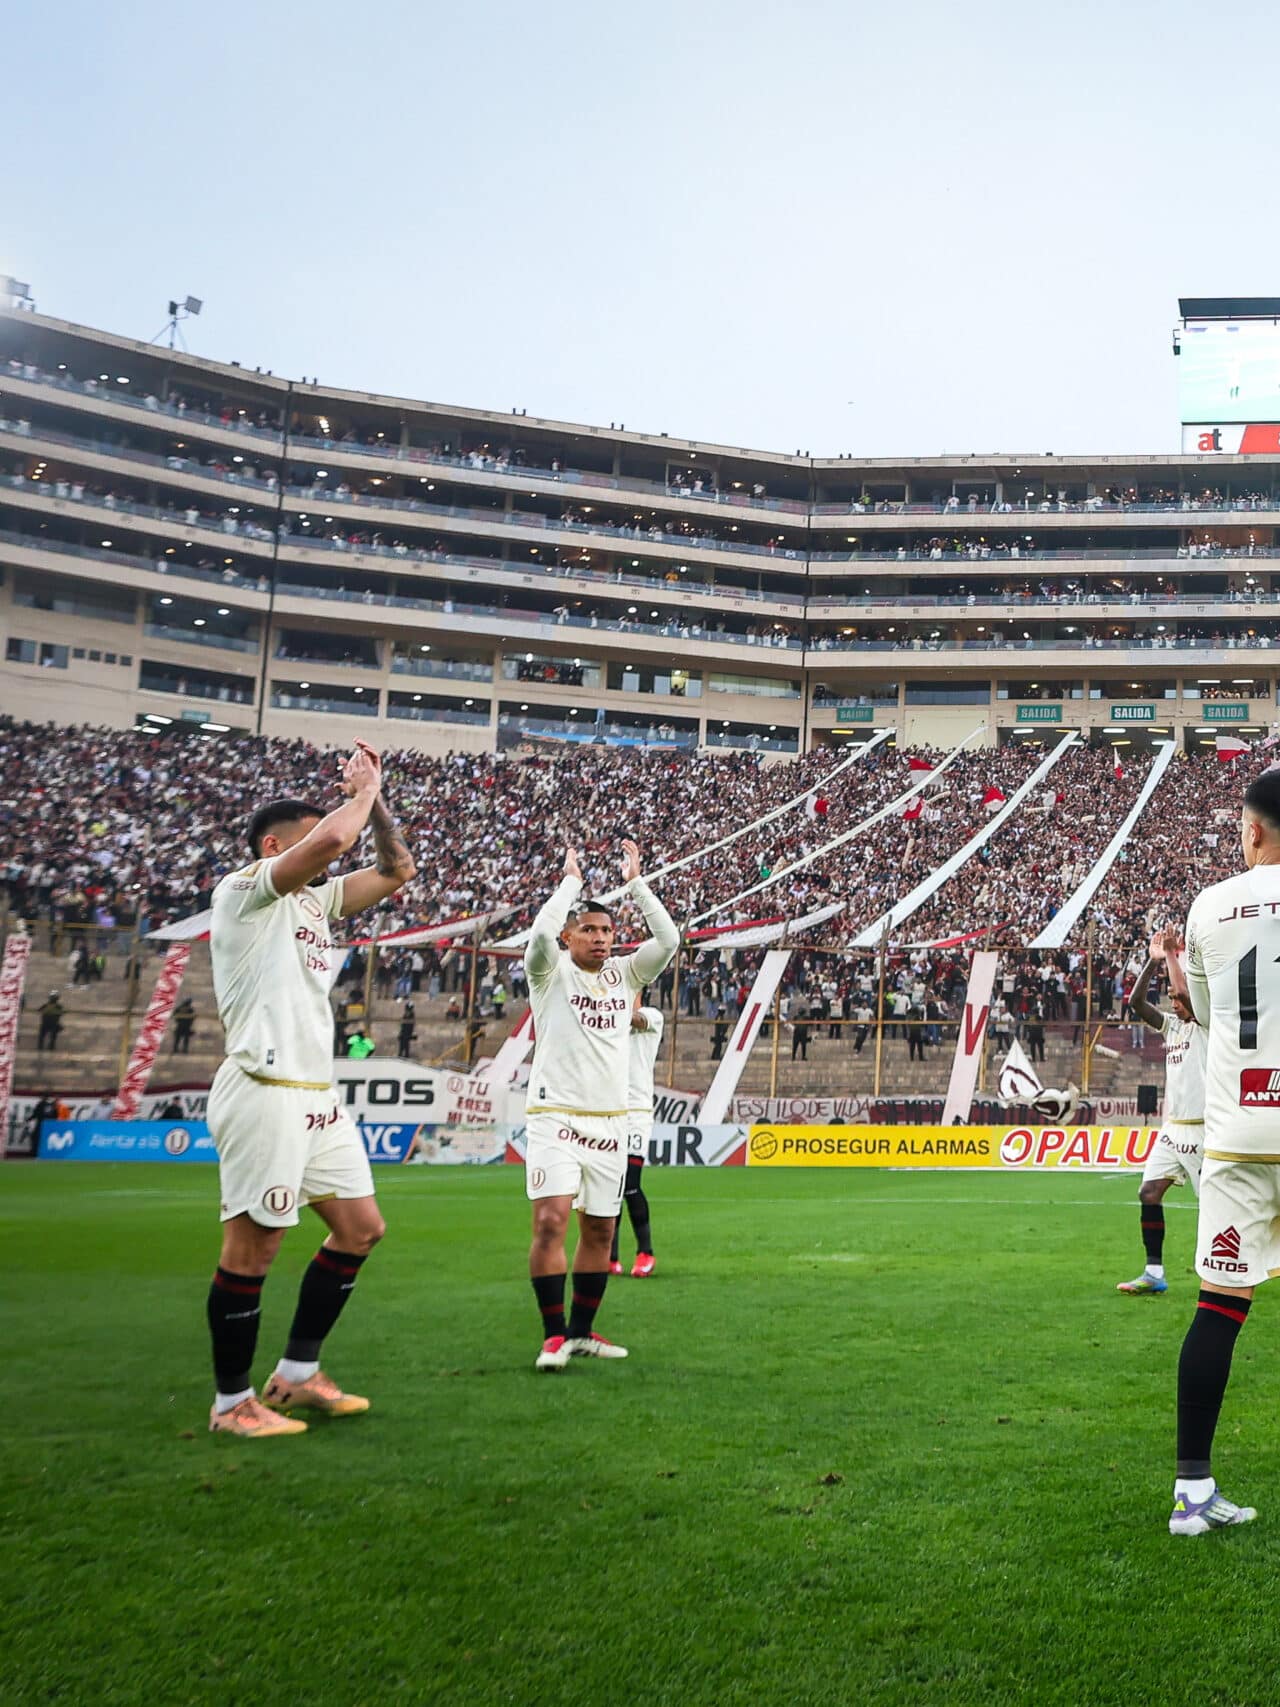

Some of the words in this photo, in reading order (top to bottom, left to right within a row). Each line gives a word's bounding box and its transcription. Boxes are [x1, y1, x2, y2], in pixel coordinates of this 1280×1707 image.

[1198, 428, 1222, 451] at
[1021, 708, 1057, 719] SALIDA
[1114, 707, 1151, 719] SALIDA
[1207, 707, 1244, 718] SALIDA
[581, 1013, 617, 1030] total
[782, 1138, 891, 1155] PROSEGUR
[896, 1138, 990, 1155] ALARMAS
[1202, 1256, 1249, 1274] ALTOS
